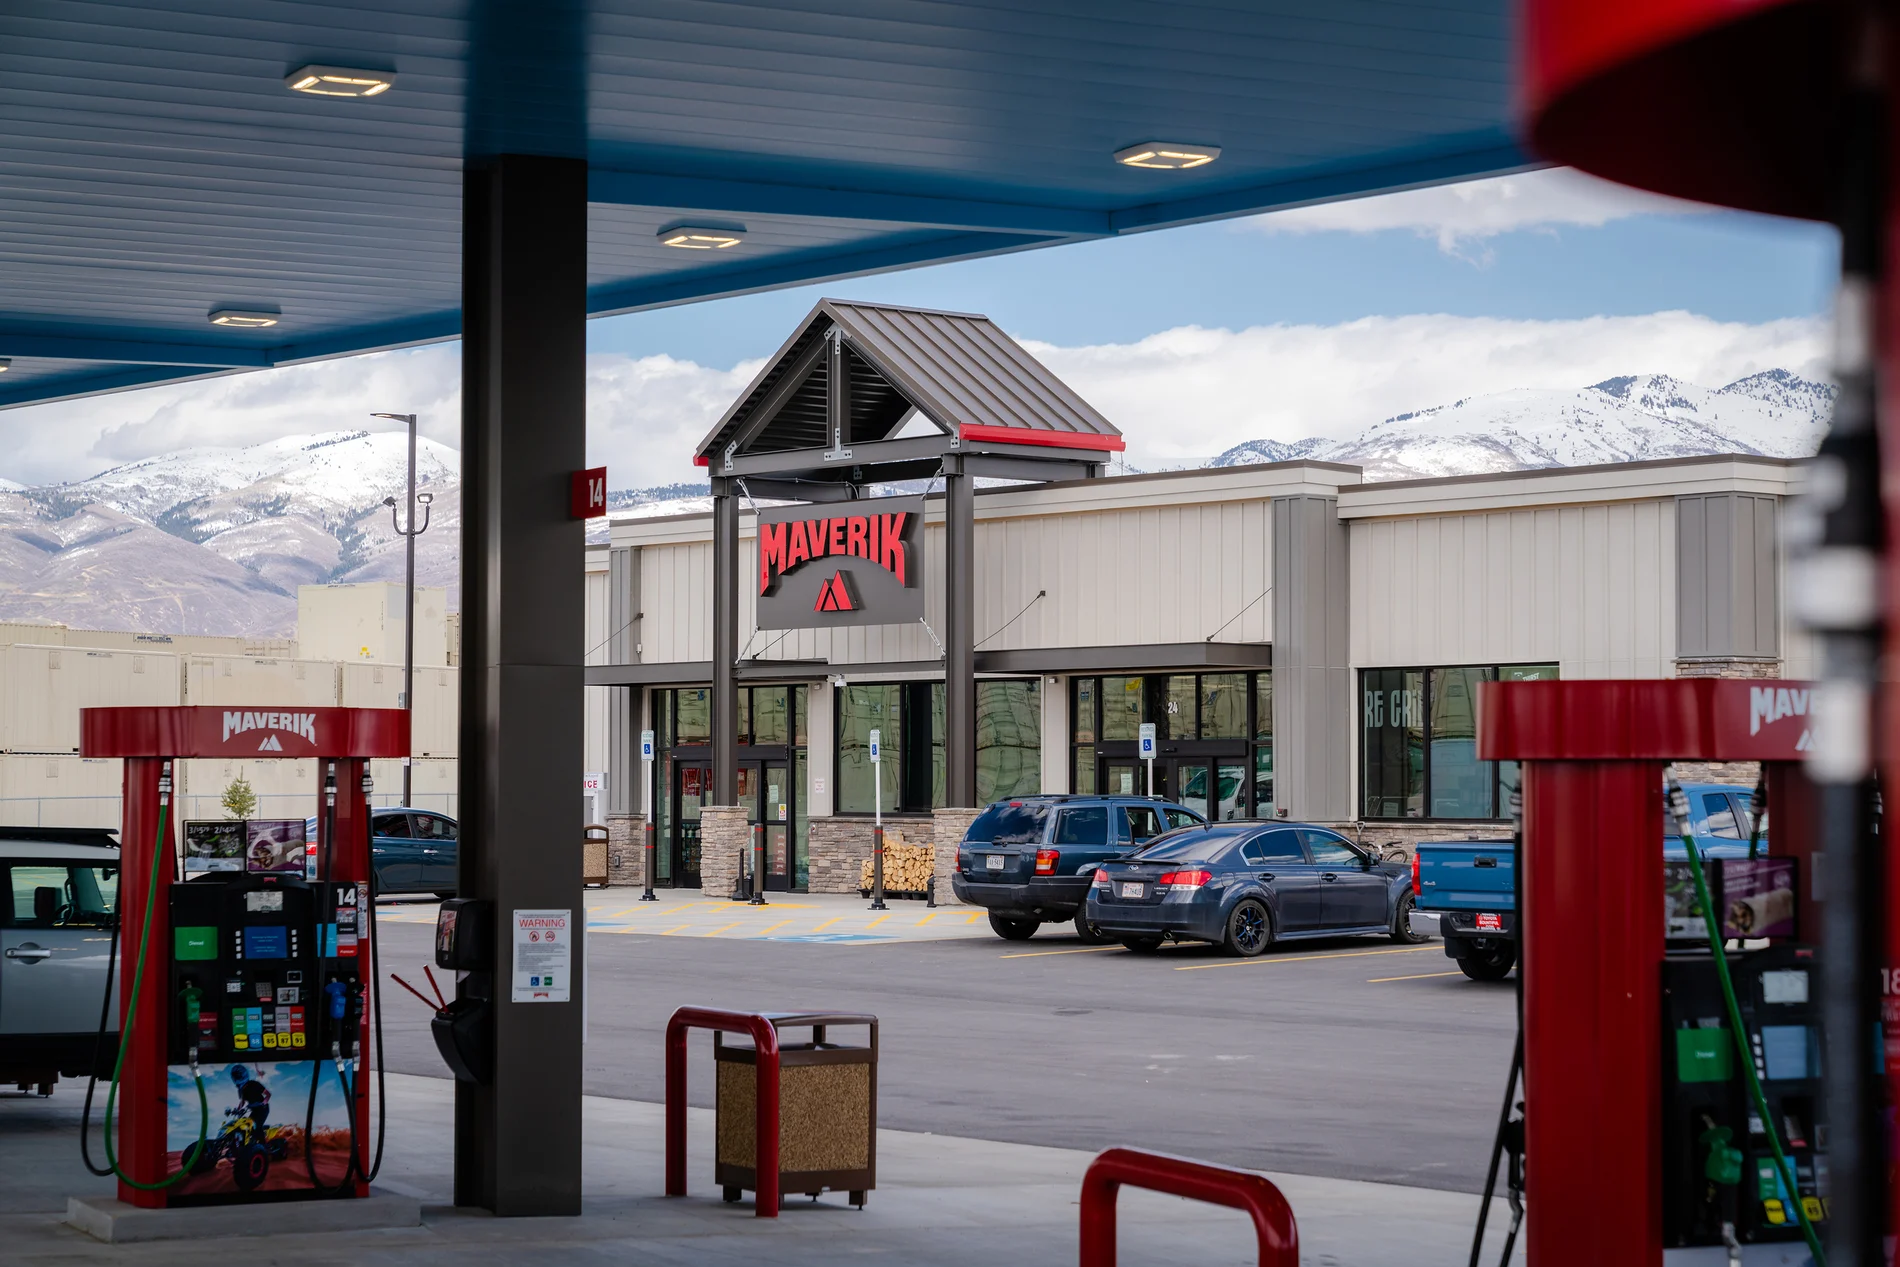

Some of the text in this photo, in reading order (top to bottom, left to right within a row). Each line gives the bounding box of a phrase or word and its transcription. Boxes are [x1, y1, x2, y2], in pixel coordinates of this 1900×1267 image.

[589, 477, 604, 508] 14
[760, 511, 911, 597] MAVERIK
[1168, 701, 1179, 714] 24
[1750, 686, 1817, 737] MAV
[222, 711, 316, 743] MAVERIK
[583, 780, 599, 789] ICE
[336, 887, 357, 906] 14
[518, 919, 566, 928] WARNING
